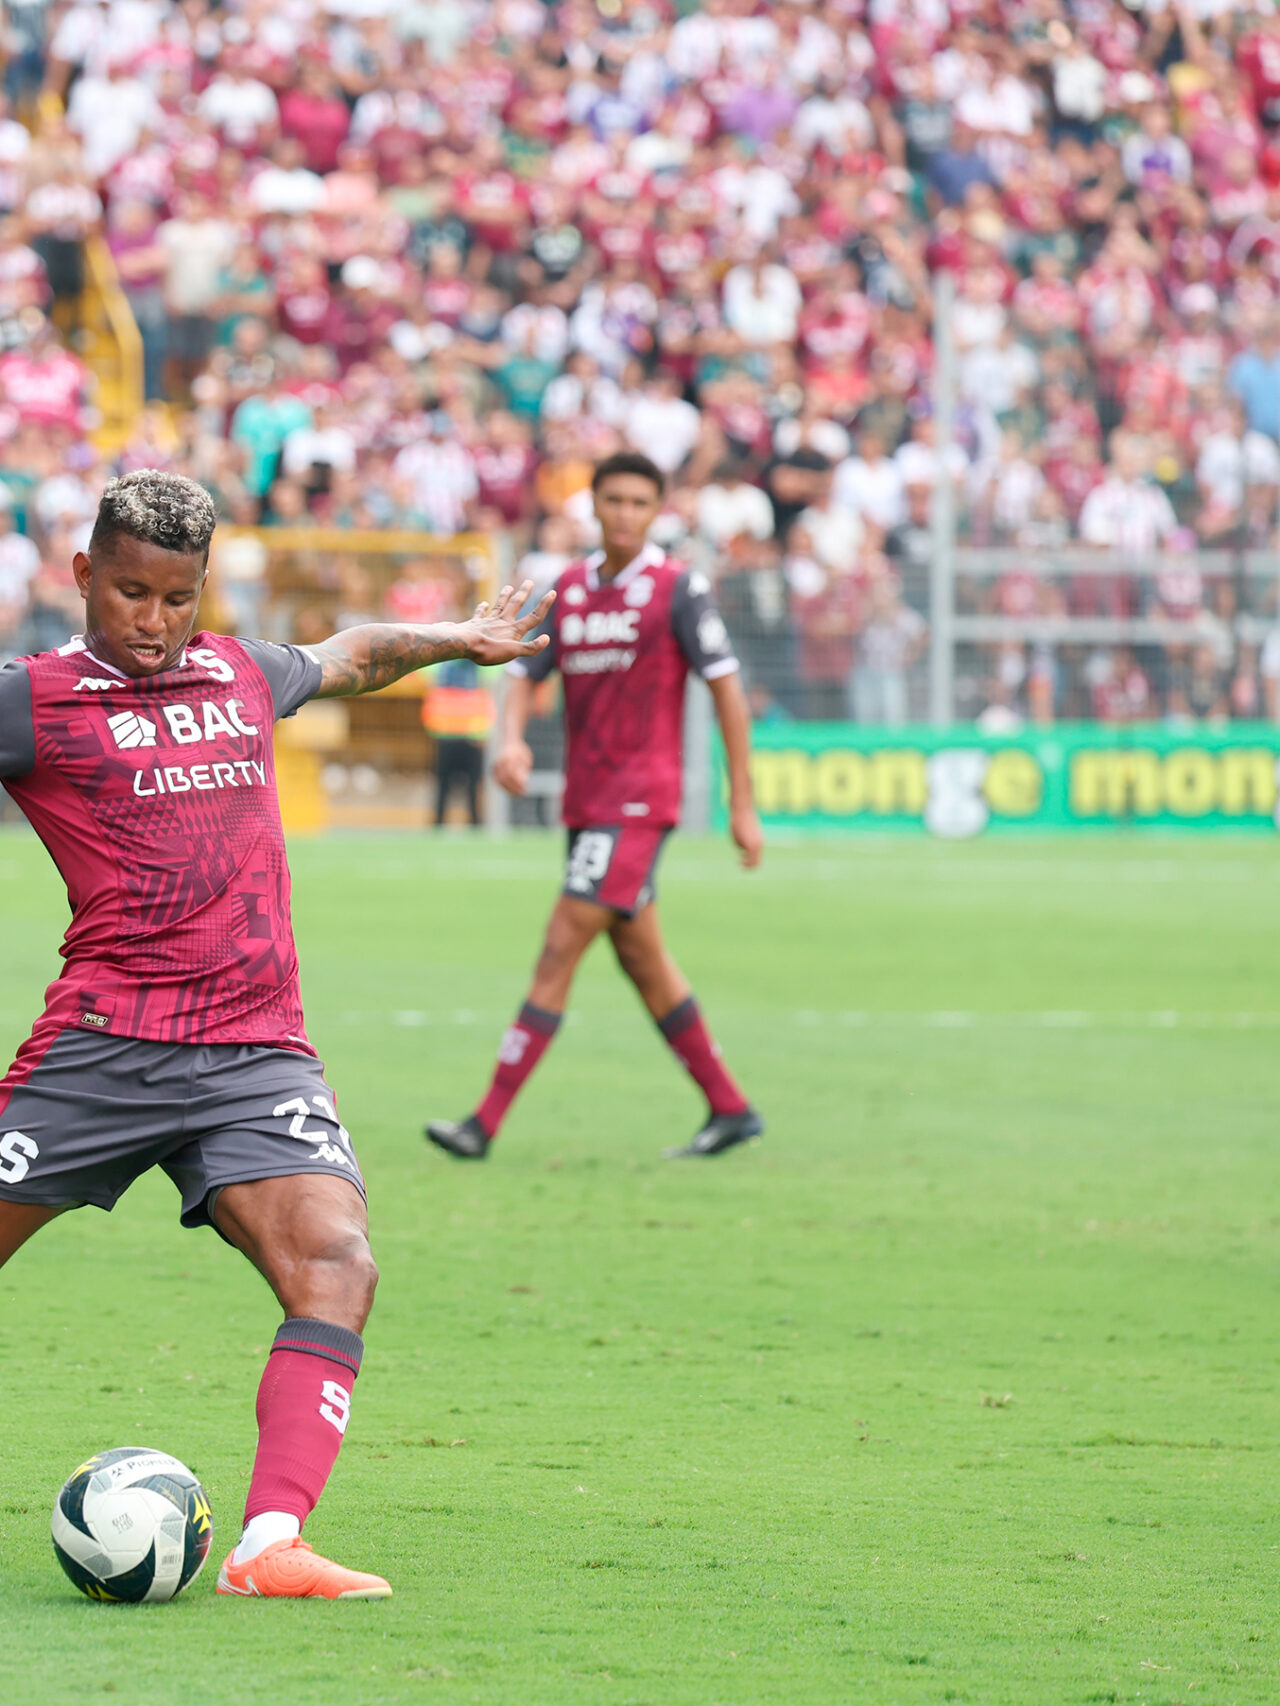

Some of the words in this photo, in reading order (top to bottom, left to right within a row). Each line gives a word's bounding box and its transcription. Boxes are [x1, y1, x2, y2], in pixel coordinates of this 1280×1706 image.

[189, 648, 235, 682] S
[163, 698, 259, 745] BAC
[133, 760, 267, 797] LIBERTY
[1070, 748, 1280, 836] mon
[318, 1380, 351, 1435] S
